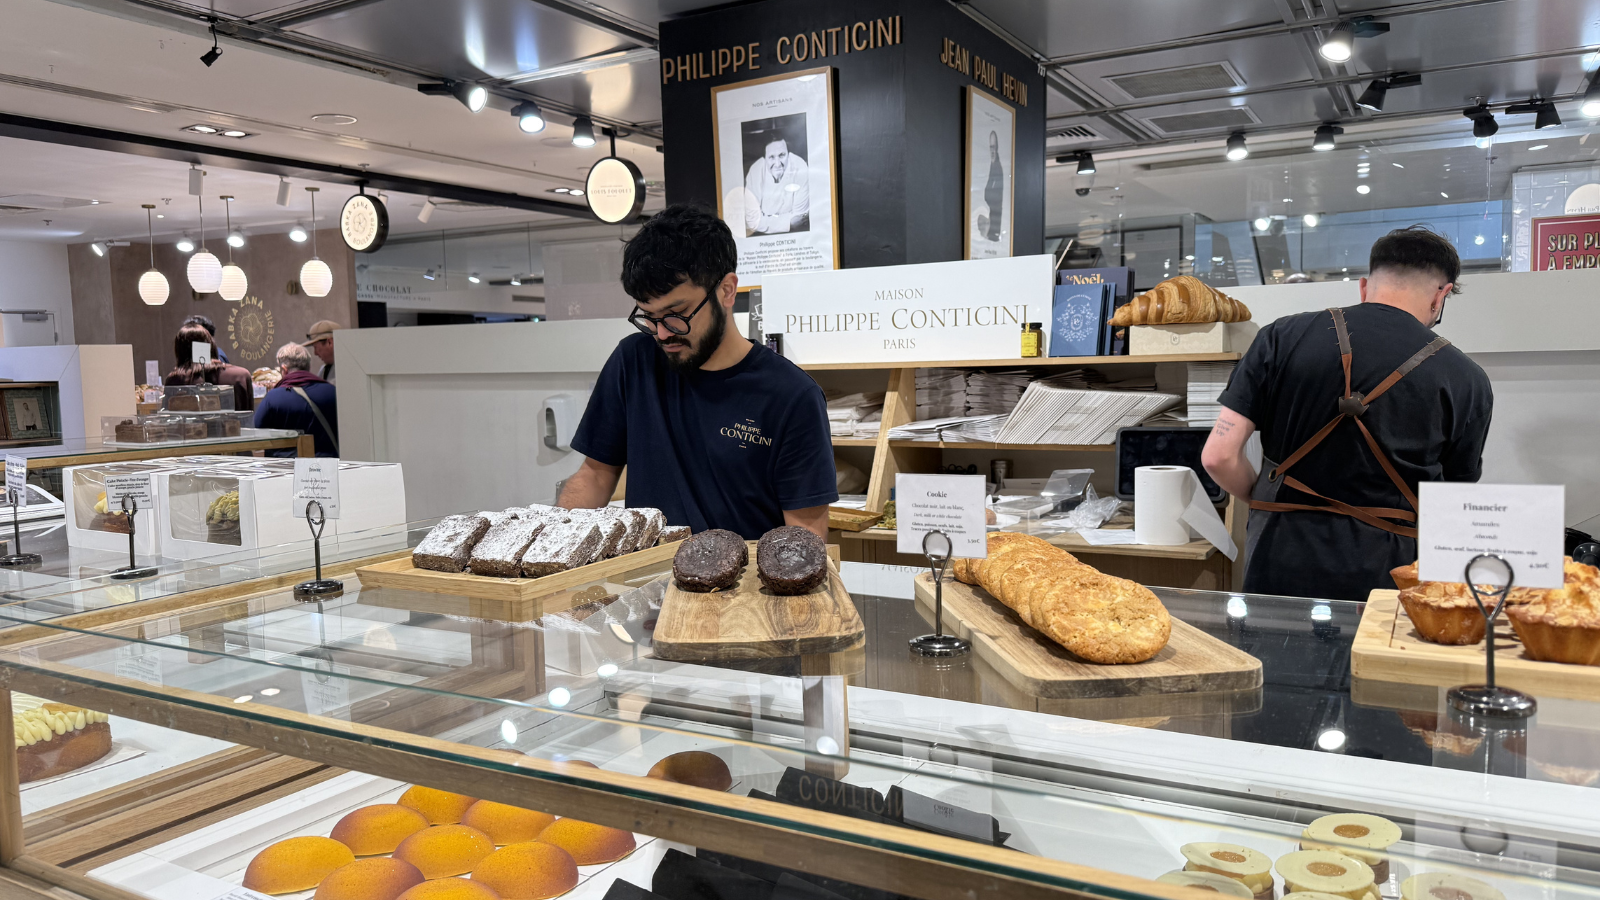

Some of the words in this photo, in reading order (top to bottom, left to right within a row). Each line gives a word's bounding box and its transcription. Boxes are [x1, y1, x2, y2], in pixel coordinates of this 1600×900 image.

[662, 42, 760, 84] PHILIPPE
[777, 16, 900, 64] CONTICINI
[941, 37, 970, 76] JEAN
[974, 55, 998, 92] PAUL
[1003, 72, 1027, 107] HEVIN
[1548, 234, 1578, 252] SUR
[1548, 254, 1556, 270] À
[1563, 254, 1600, 270] EMP
[367, 284, 411, 294] CHOCOLAT
[874, 288, 924, 300] MAISON
[239, 296, 263, 309] ZANA
[785, 312, 880, 334] PHILIPPE
[892, 304, 1028, 329] CONTICINI
[228, 308, 239, 350] BABKA
[241, 310, 274, 360] BOULANGERIE
[884, 338, 916, 349] PARIS
[720, 427, 772, 446] CONTICINI
[734, 422, 761, 435] PHILIPPE
[1463, 503, 1508, 512] Financier
